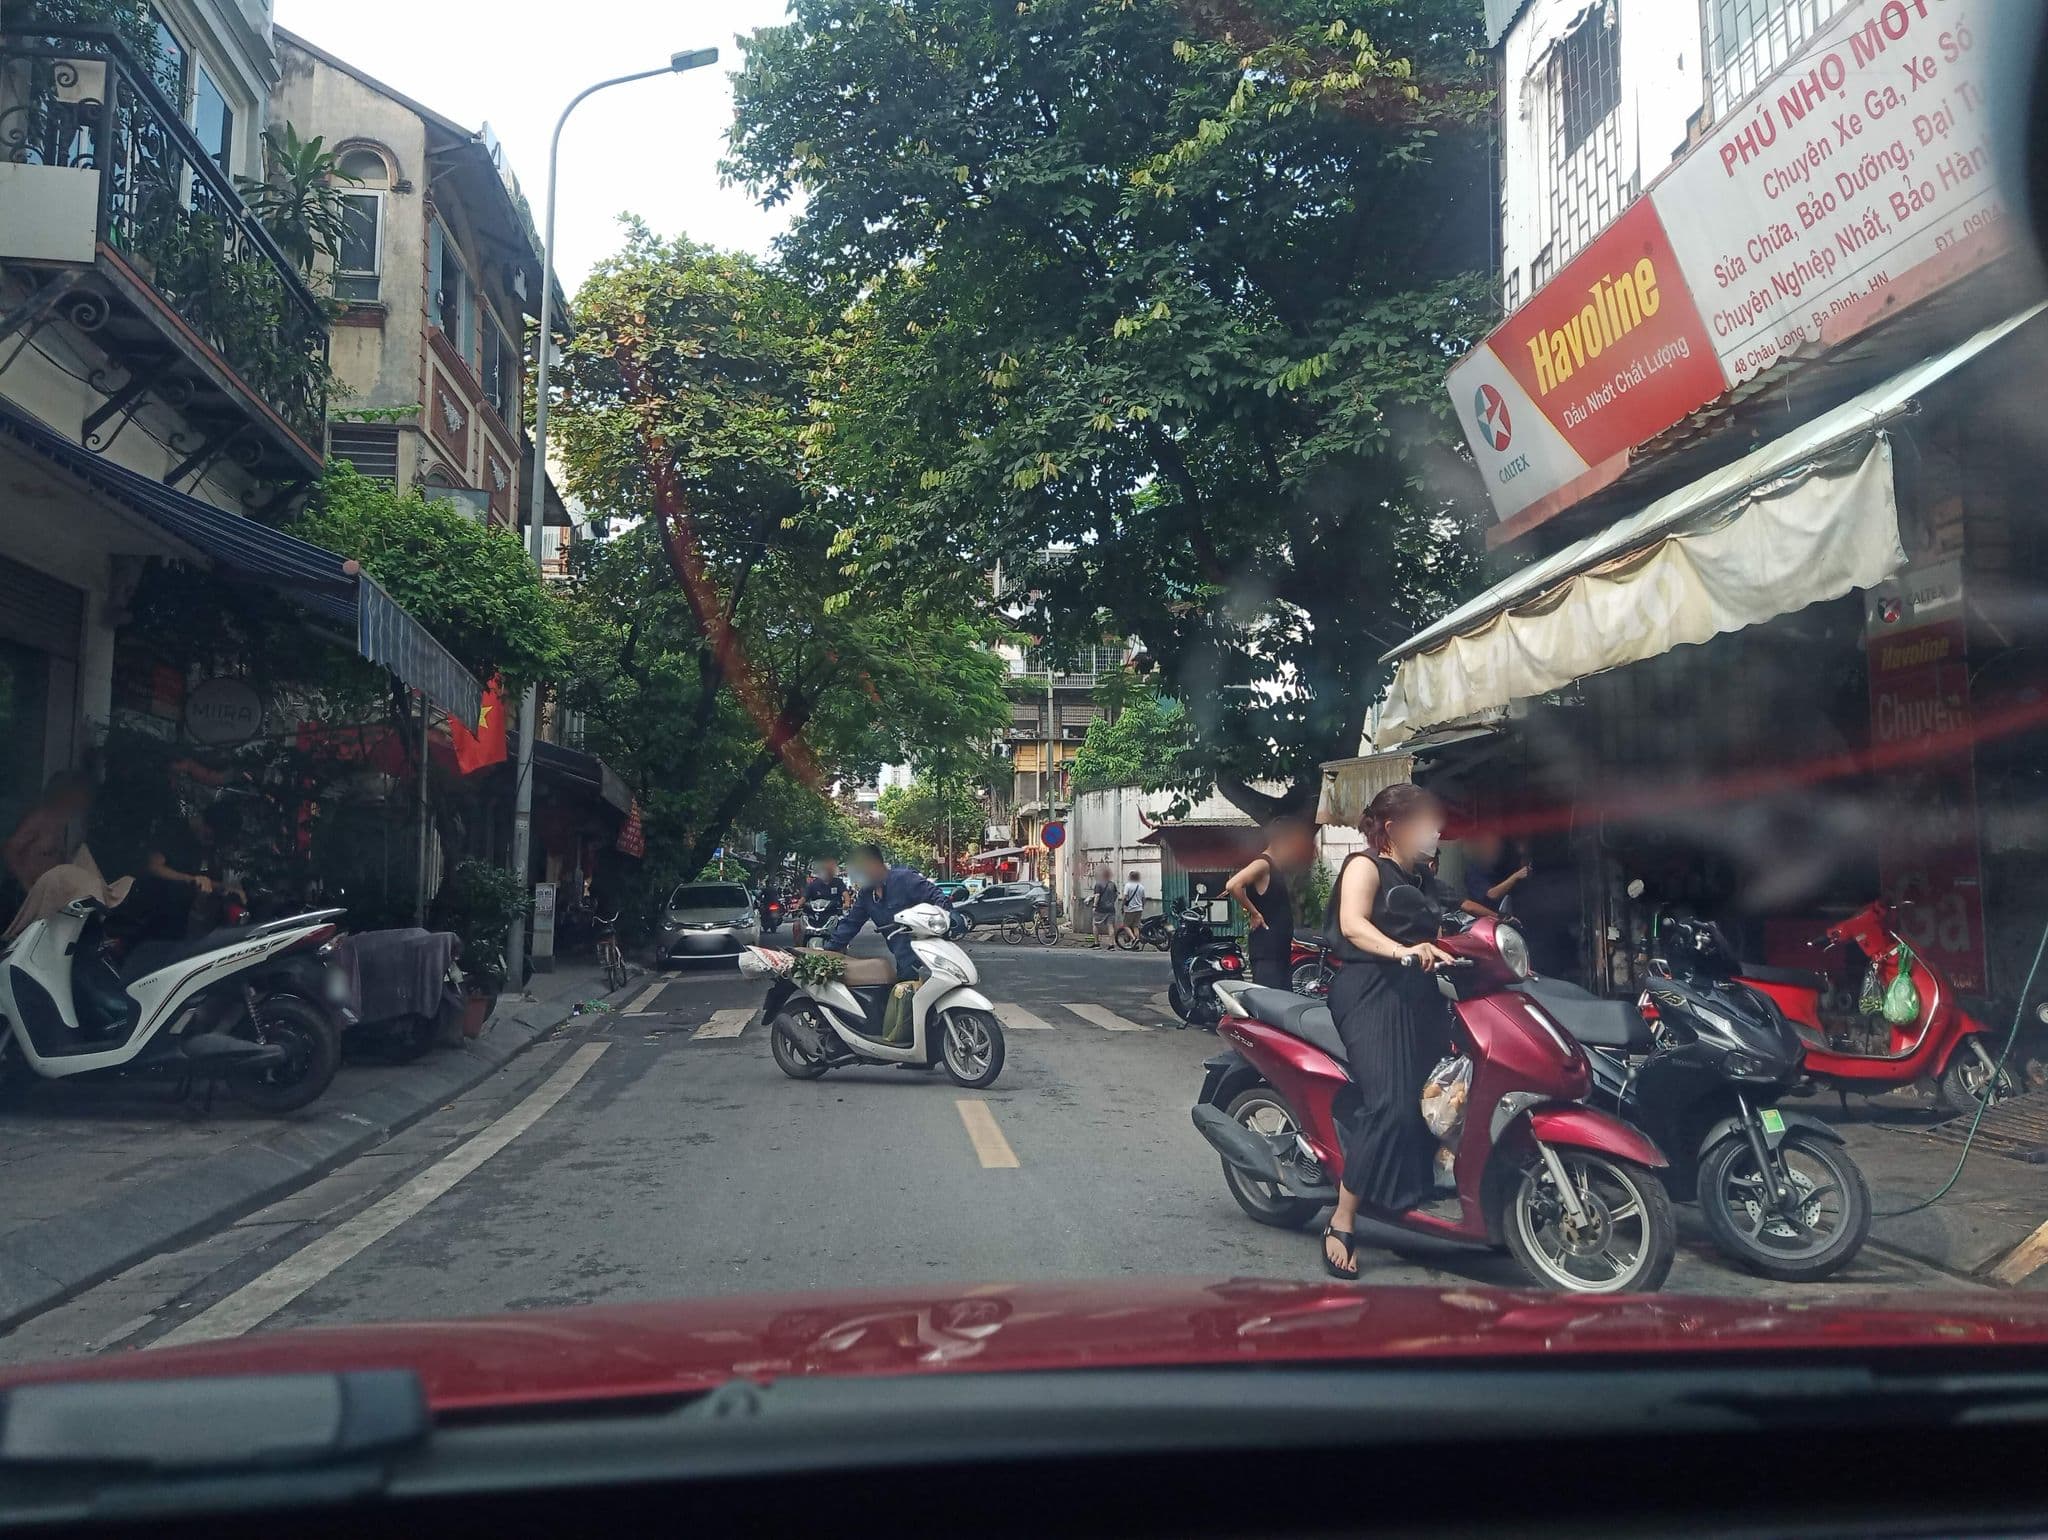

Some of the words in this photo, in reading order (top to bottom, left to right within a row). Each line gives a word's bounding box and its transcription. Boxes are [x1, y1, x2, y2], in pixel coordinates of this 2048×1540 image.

[1719, 103, 1777, 178] PHÚ
[1777, 53, 1846, 129] NHỌ
[1762, 137, 1834, 200] Chuyên
[1831, 112, 1863, 148] Xe
[1864, 85, 1908, 121] Ga,
[1902, 56, 1938, 93] Xe
[1937, 12, 1974, 65] Số
[1713, 255, 1747, 289] Sửa
[1747, 222, 1799, 265] Chữa,
[1796, 191, 1837, 230] Bảo
[1834, 139, 1916, 202] Dưỡng,
[1912, 99, 1956, 148] Đại
[1713, 290, 1771, 338] Chuyên
[1770, 250, 1836, 298] Nghiệp
[1835, 206, 1893, 259] Nhất,
[1888, 174, 1936, 223] Bảo
[1526, 257, 1661, 397] Havoline
[1563, 400, 1588, 429] Dầu
[1586, 381, 1617, 412] Nhớt
[1615, 359, 1645, 393] Chất
[1645, 335, 1691, 374] Lượng
[1734, 359, 1748, 375] 48
[1747, 343, 1777, 368] Châu
[1774, 326, 1805, 351] Long
[1868, 270, 1889, 292] HN
[1498, 453, 1531, 485] CALTEX
